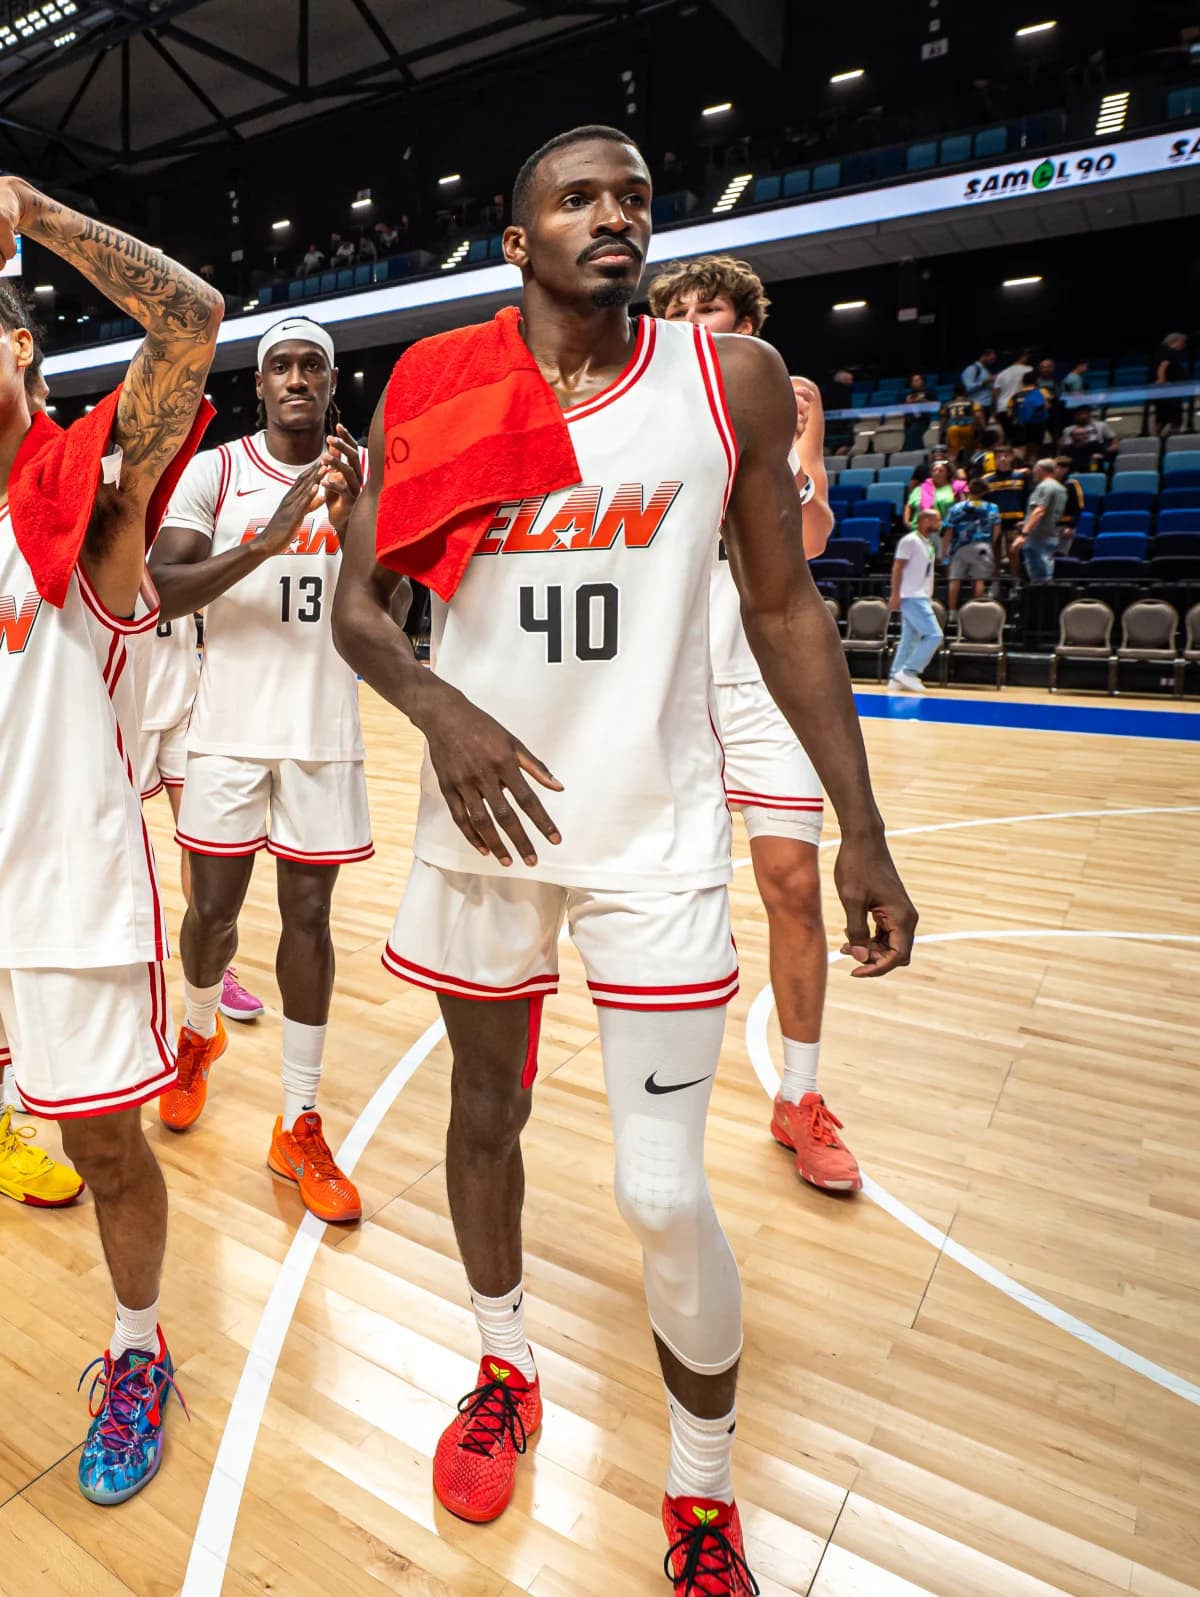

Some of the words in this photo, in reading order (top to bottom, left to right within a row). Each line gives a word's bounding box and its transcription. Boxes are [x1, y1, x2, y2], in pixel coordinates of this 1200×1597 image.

[1077, 153, 1116, 173] 90
[472, 480, 684, 556] ELAN
[279, 576, 323, 623] 13
[518, 582, 619, 664] 40
